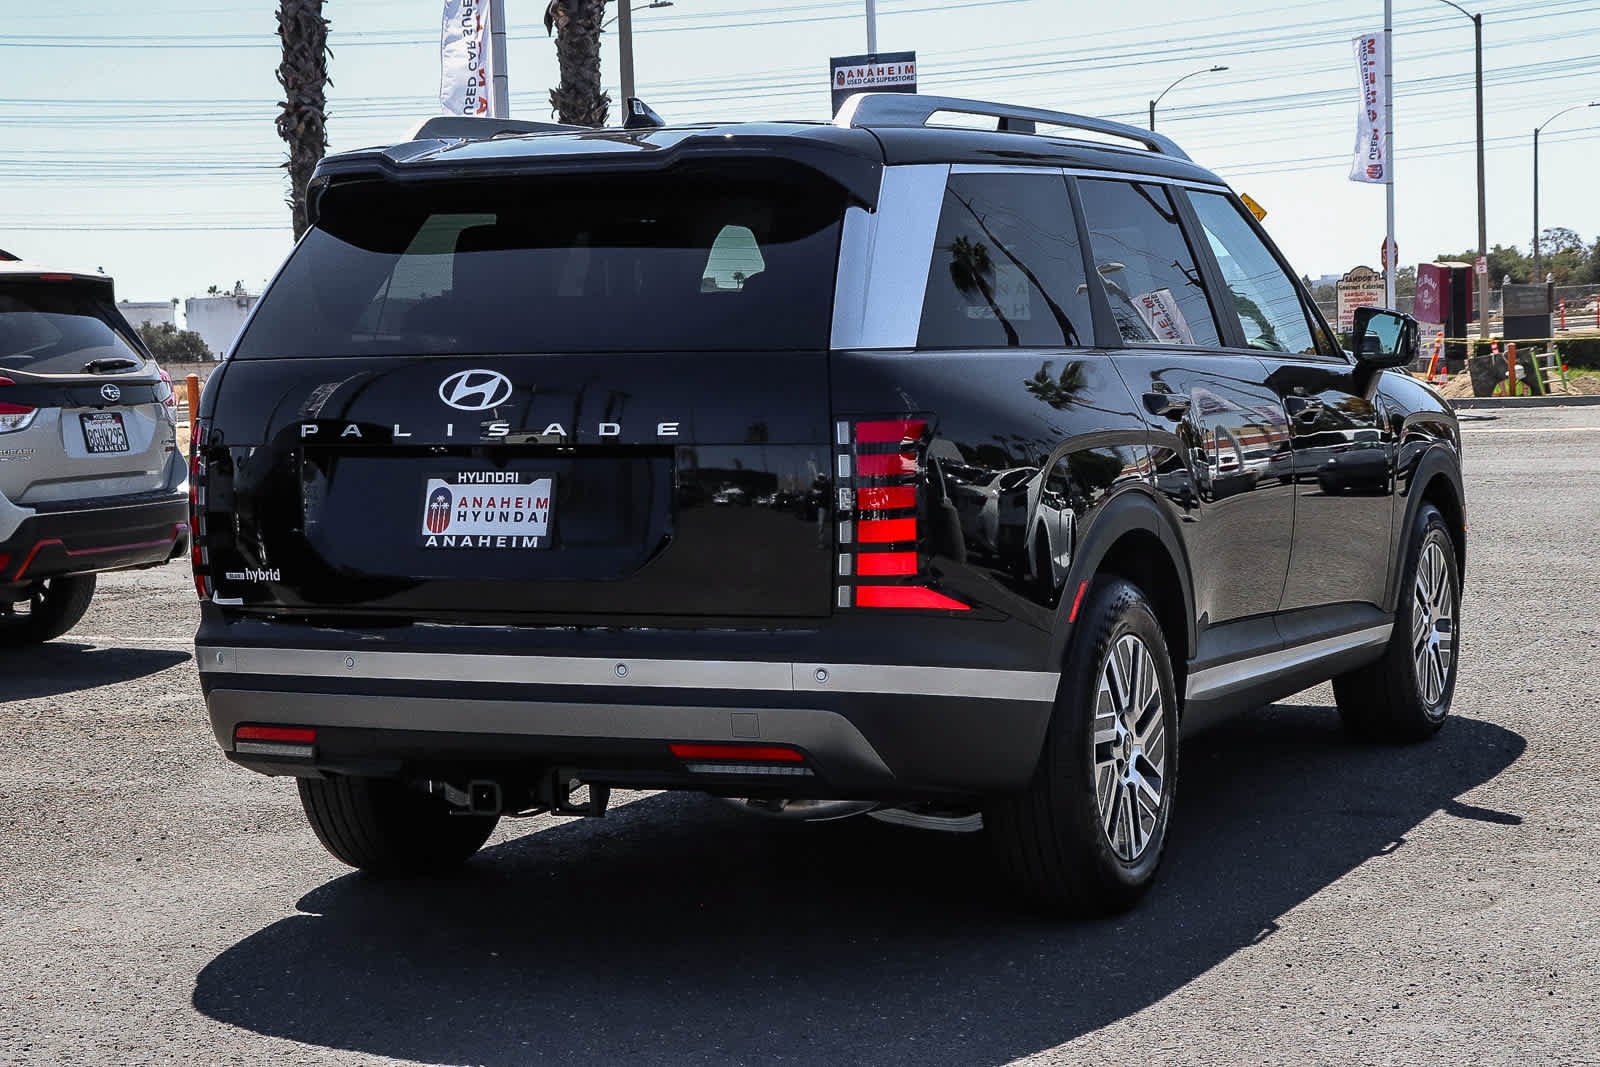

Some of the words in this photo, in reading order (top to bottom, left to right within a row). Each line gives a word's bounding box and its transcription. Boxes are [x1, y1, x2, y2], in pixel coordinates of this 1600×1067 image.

[847, 64, 915, 78] ANAHEIM
[876, 75, 915, 83] SUPERSTORE
[301, 422, 680, 438] PALISADE
[458, 471, 519, 483] HYUNDAI
[458, 496, 549, 509] ANAHEIM
[457, 510, 548, 523] HYUNDAI
[425, 535, 538, 548] ANAHEIM
[245, 567, 281, 583] hybrid
